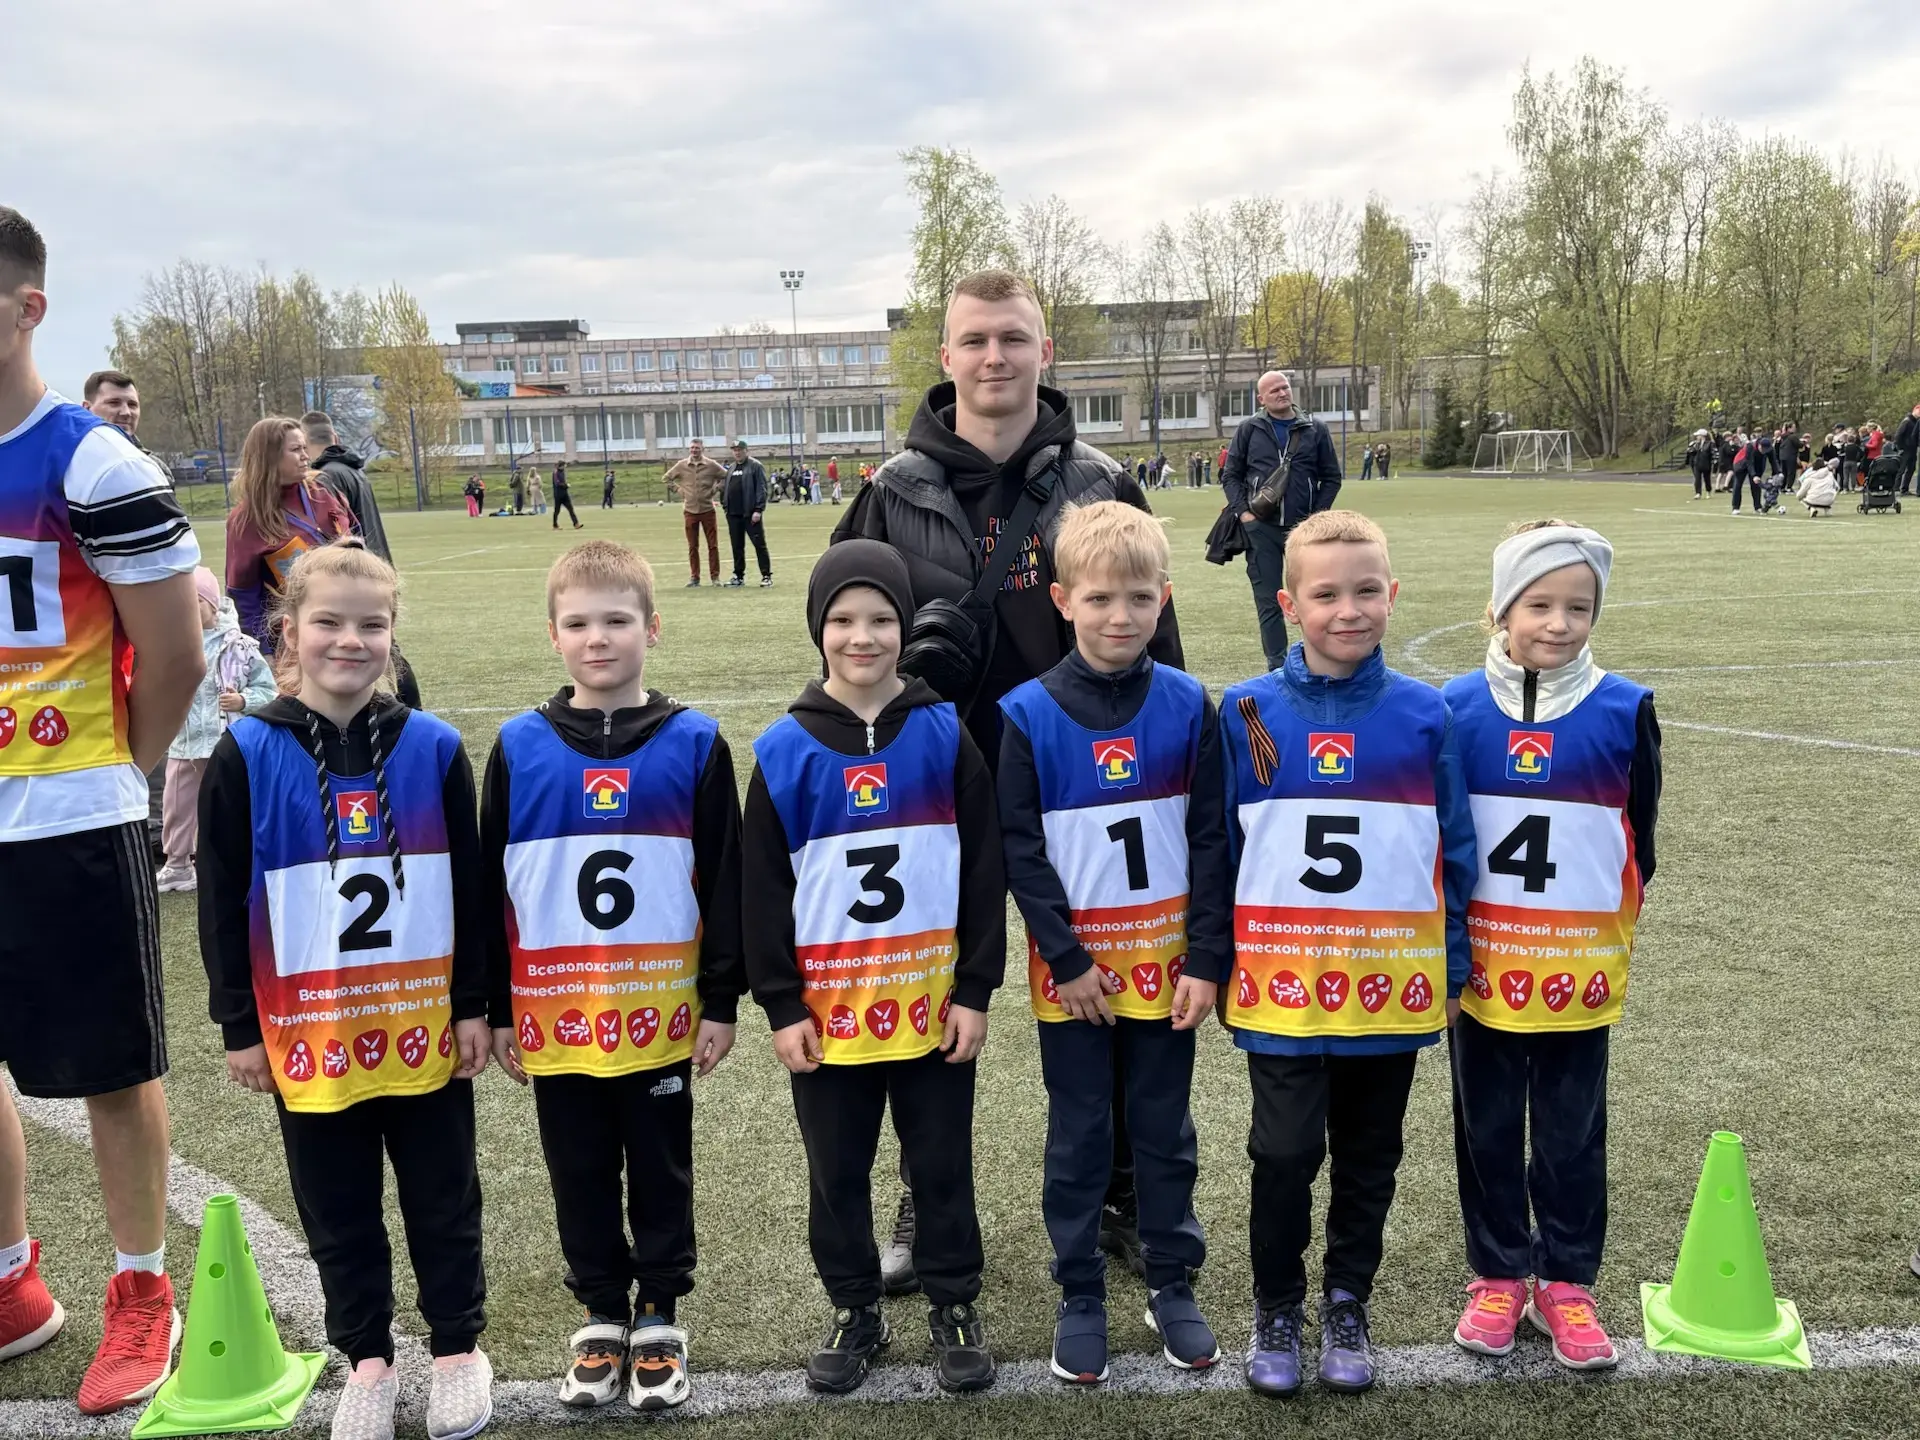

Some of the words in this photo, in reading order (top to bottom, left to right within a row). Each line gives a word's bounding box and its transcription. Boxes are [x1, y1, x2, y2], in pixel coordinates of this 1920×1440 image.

[0, 555, 38, 632] 1
[0, 661, 43, 672] ентр
[1106, 816, 1150, 891] 1
[1298, 814, 1363, 894] 5
[1487, 814, 1557, 893] 4
[577, 849, 635, 930] 6
[846, 843, 905, 924] 3
[338, 873, 392, 953] 2
[1070, 913, 1167, 934] севоложский
[1248, 919, 1366, 936] Всеволожский
[1370, 927, 1416, 940] центр
[1467, 915, 1552, 937] воложский
[1555, 927, 1599, 940] центр
[1116, 931, 1184, 951] культуры
[1235, 942, 1300, 955] зической
[1304, 945, 1385, 960] культуры
[1389, 948, 1399, 958] и
[1490, 941, 1570, 960] культуры
[1573, 948, 1583, 958] и
[639, 959, 684, 972] центр
[804, 949, 912, 971] Всеволожский
[915, 944, 953, 960] центр
[404, 975, 447, 991] центр
[511, 980, 585, 997] изической
[588, 980, 653, 996] культуры
[657, 980, 667, 991] и
[856, 968, 929, 990] культуры
[343, 999, 420, 1018] культуры
[423, 997, 433, 1008] и
